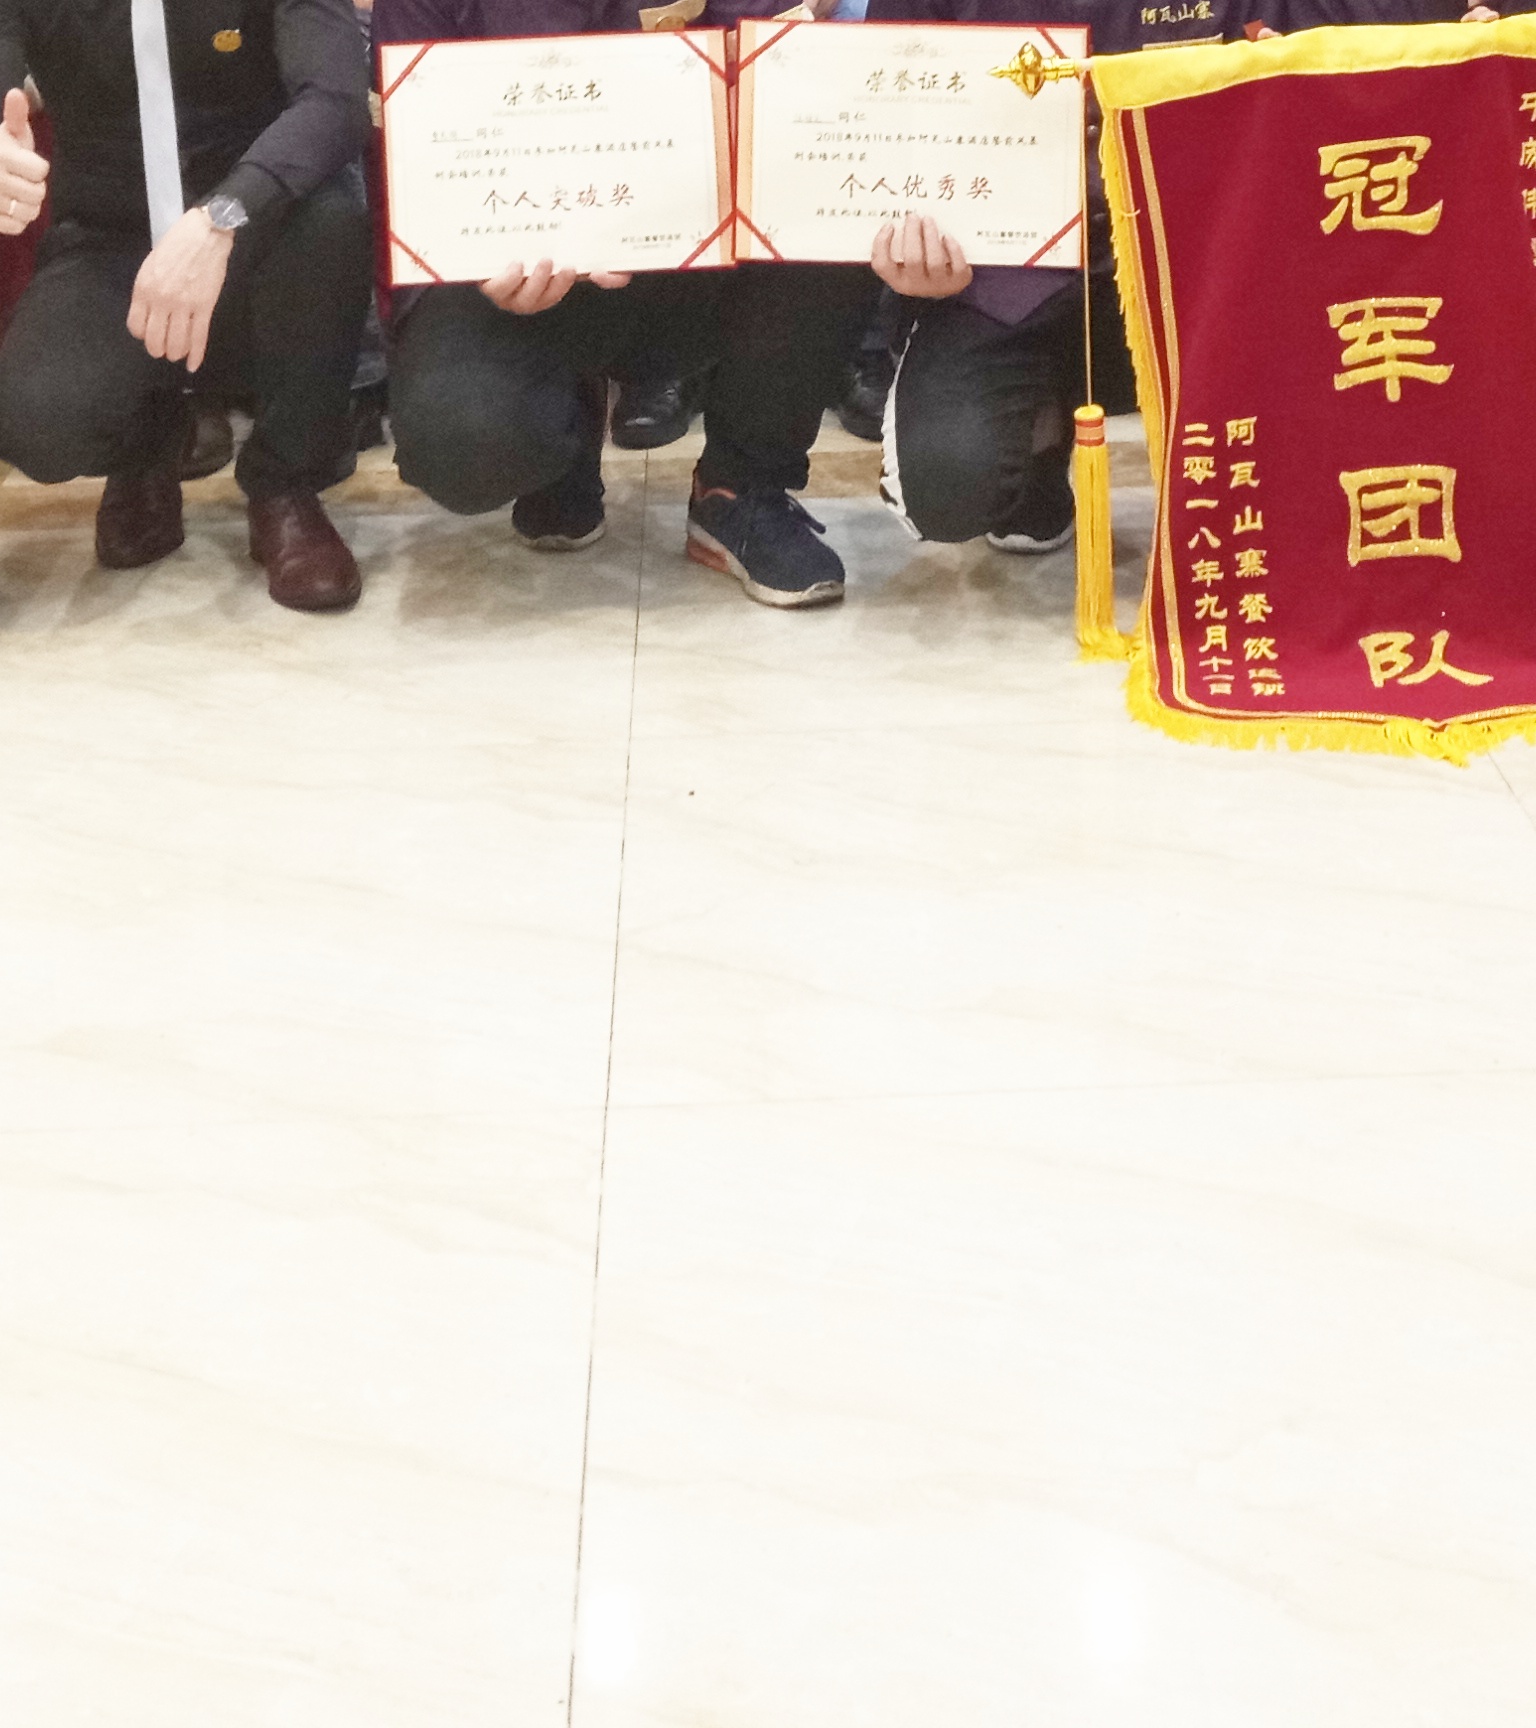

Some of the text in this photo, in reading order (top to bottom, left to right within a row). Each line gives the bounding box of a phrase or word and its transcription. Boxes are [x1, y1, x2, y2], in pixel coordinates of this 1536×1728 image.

[1141, 0, 1215, 25] 阿瓦山寨
[502, 78, 603, 106] 荣誉证书
[865, 68, 968, 93] 荣誉证书
[483, 183, 635, 215] 个人突破奖
[839, 173, 994, 202] 个人优秀奖
[1319, 135, 1494, 688] 冠军团队
